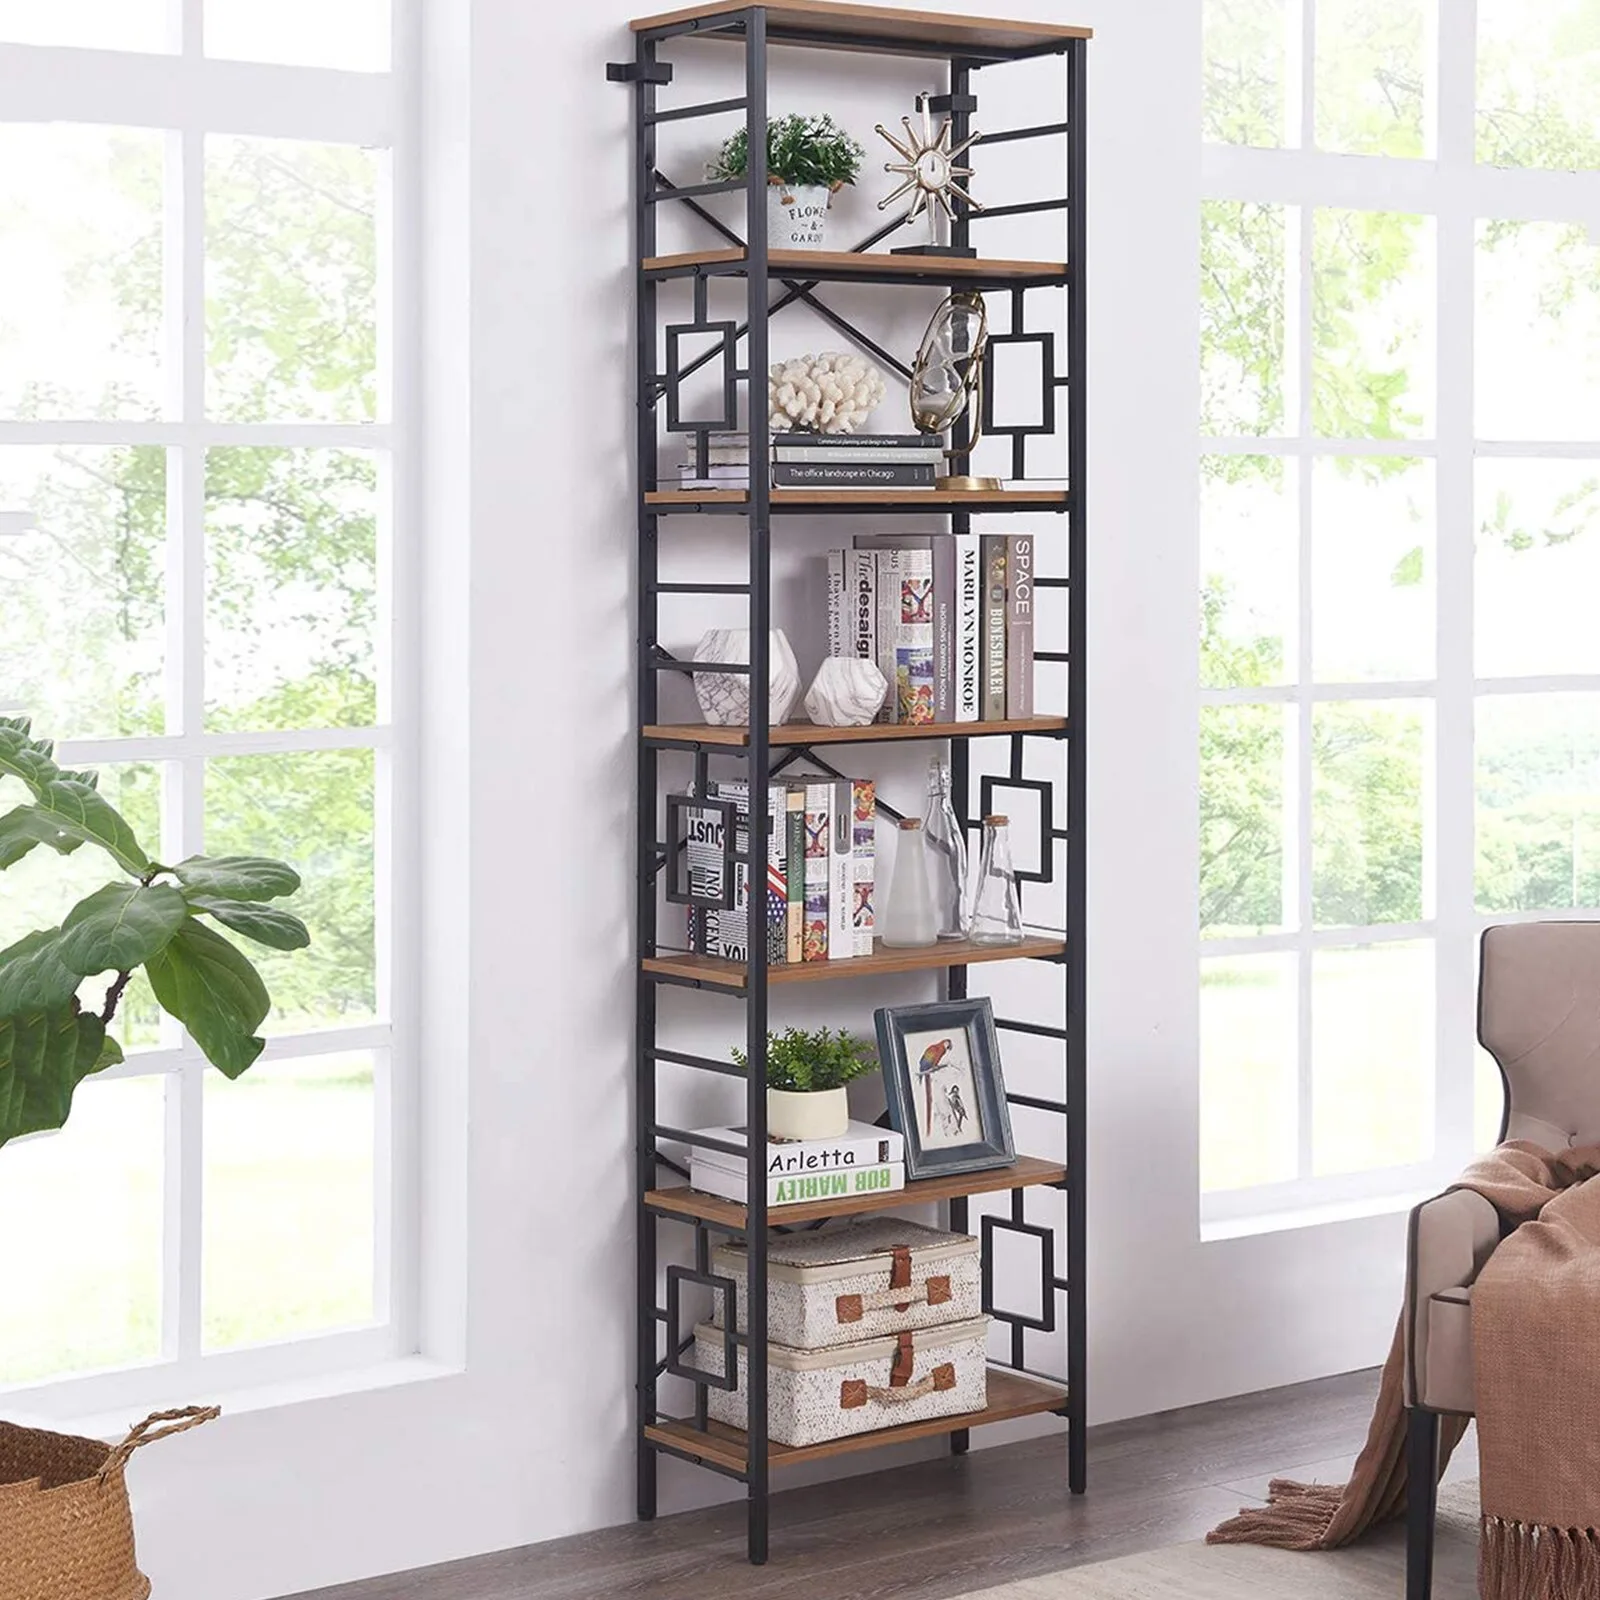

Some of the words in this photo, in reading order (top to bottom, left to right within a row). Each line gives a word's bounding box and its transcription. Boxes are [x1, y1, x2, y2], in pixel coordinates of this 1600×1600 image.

[790, 468, 803, 477] The
[804, 468, 824, 478] office
[824, 468, 858, 479] landscape
[859, 468, 867, 477] in
[867, 469, 895, 480] Chicago
[963, 550, 975, 632] MARILYN
[1015, 540, 1031, 615] SPACE
[963, 636, 975, 713] MONROE
[990, 608, 1004, 695] BONESHAKER
[769, 1149, 855, 1173] Arletta
[855, 1169, 891, 1192] BOB
[776, 1173, 847, 1202] MARLEY
